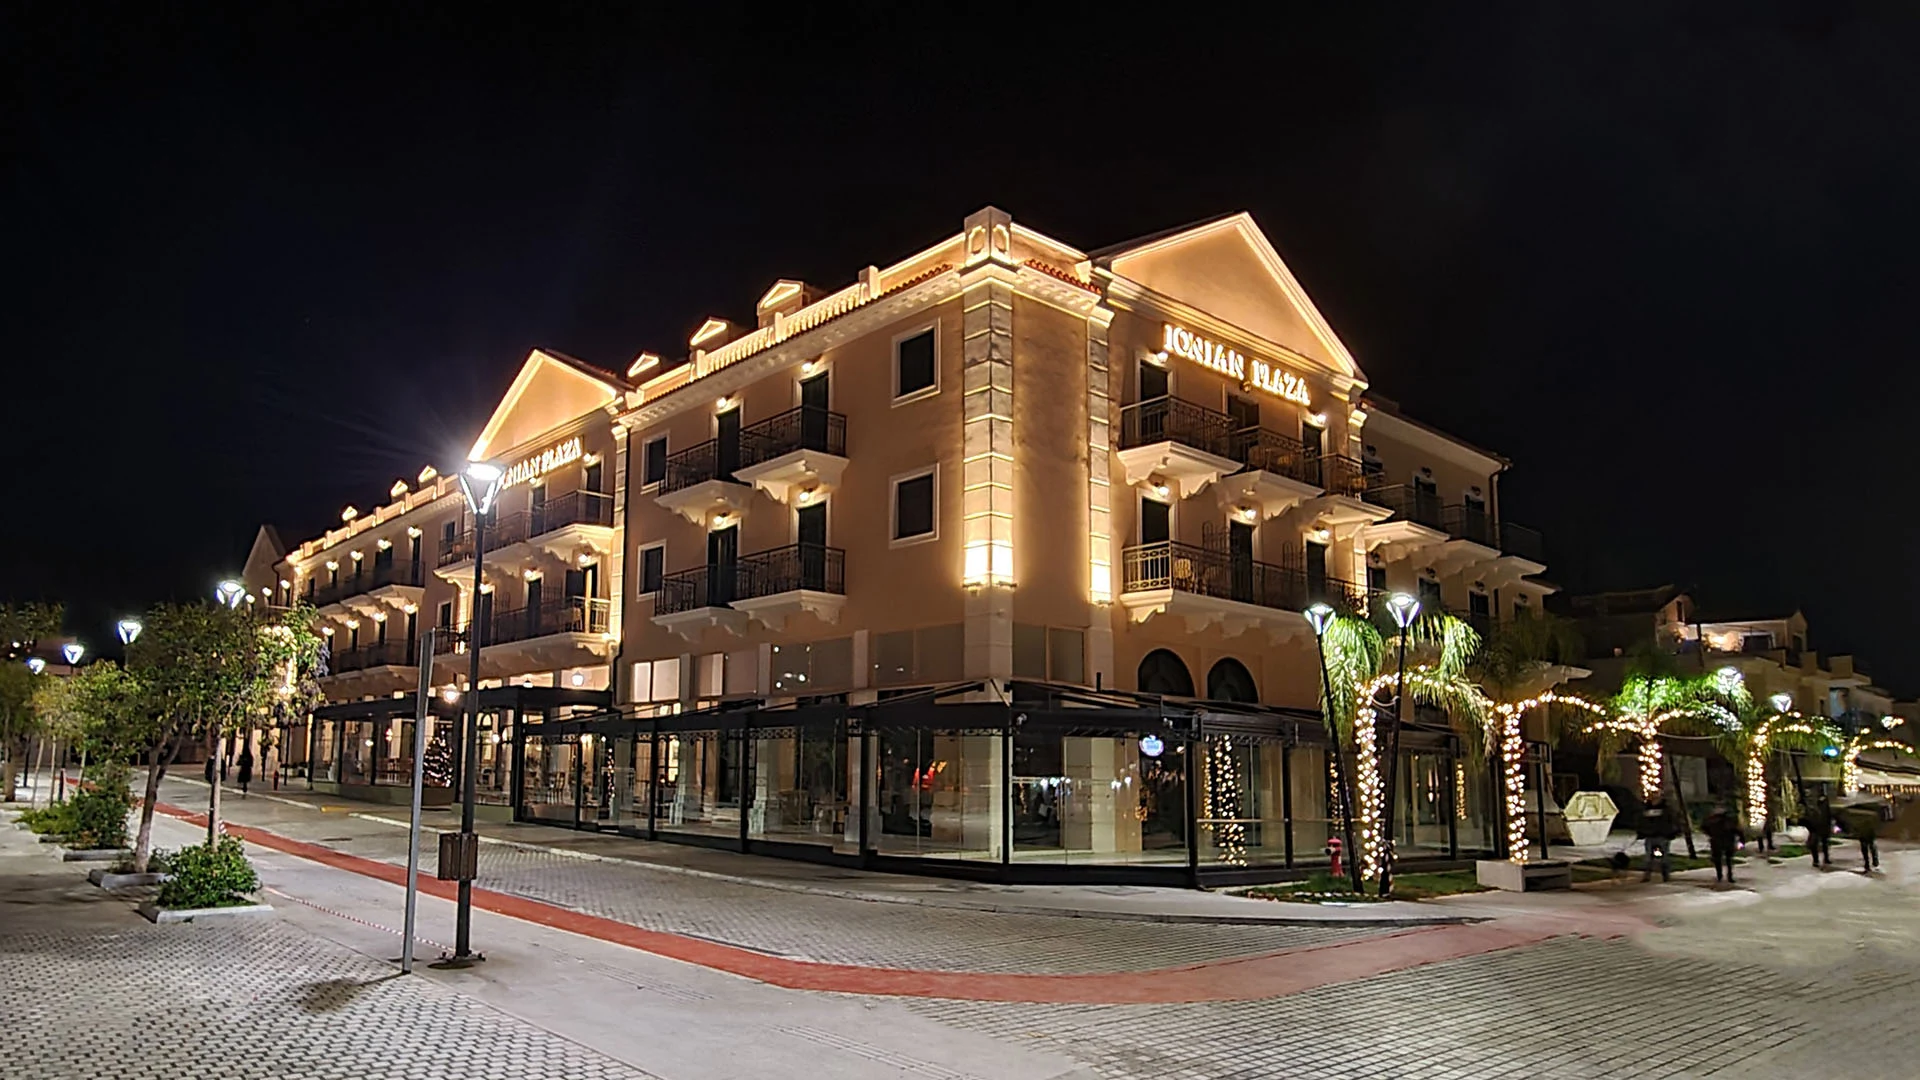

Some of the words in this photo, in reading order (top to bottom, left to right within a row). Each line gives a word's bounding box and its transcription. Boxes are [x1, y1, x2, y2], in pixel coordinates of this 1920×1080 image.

[1163, 323, 1245, 381] IONIAN
[1251, 359, 1311, 407] PLAZA
[500, 454, 541, 490] NIAN
[541, 436, 582, 474] PLAZA
